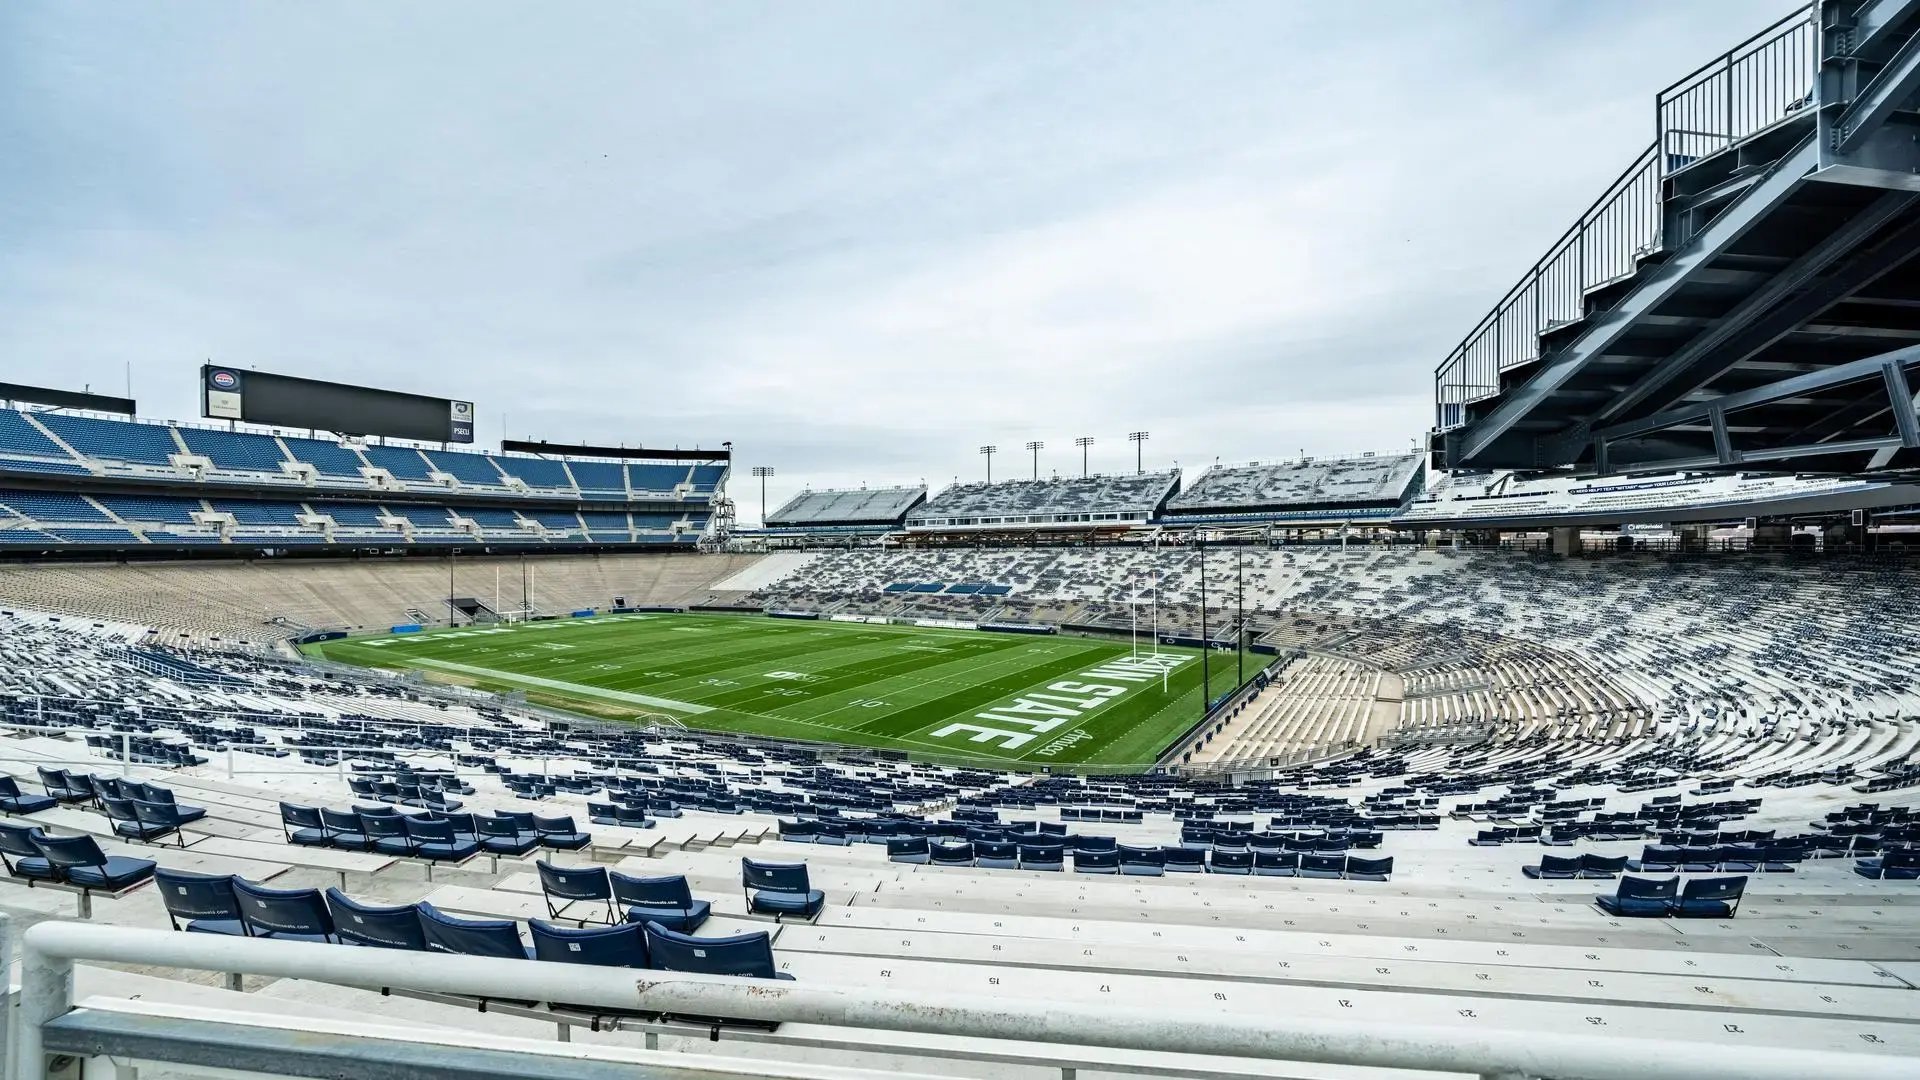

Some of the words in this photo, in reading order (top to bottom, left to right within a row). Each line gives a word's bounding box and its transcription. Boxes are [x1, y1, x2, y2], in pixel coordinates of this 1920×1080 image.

[928, 681, 1128, 749] STATE
[1036, 729, 1094, 756] Amica
[879, 970, 892, 978] 13
[1375, 968, 1390, 976] 23
[988, 976, 1000, 984] 15
[1099, 984, 1110, 992] 17
[1213, 992, 1228, 1000] 19
[1337, 1000, 1352, 1008] 21
[1583, 1016, 1608, 1026] 25
[1721, 1024, 1744, 1034] 27
